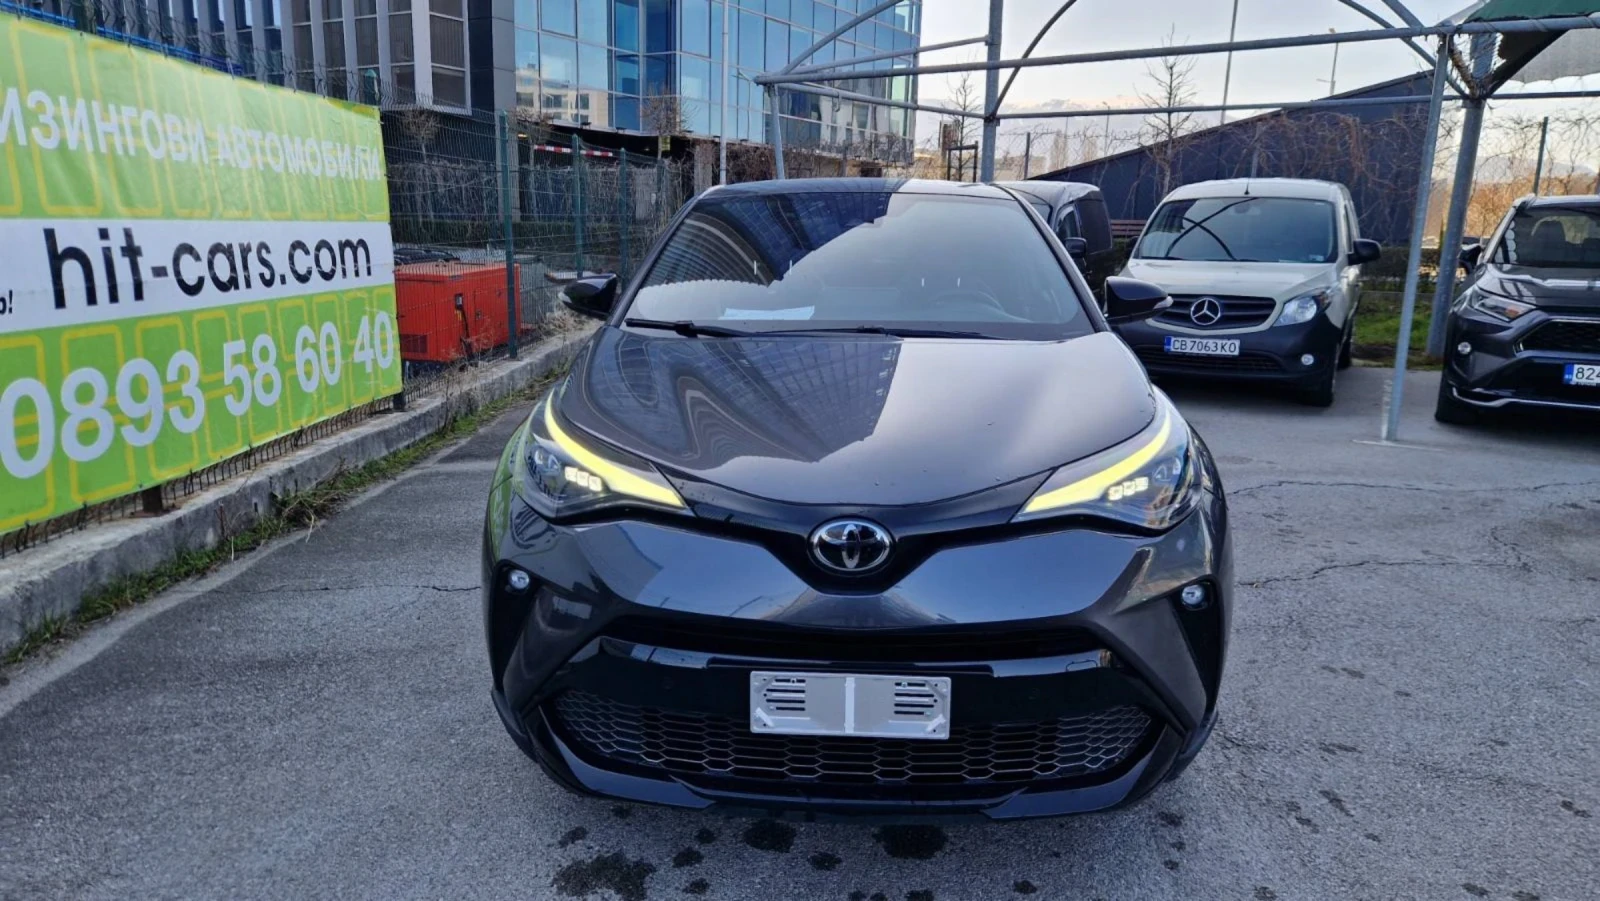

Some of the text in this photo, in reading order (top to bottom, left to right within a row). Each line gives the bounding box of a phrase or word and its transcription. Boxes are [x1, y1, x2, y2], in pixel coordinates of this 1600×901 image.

[216, 123, 381, 181] АВТОМОБИЛИ
[43, 227, 372, 310] hit-cars.com
[0, 310, 394, 479] 0893 58 60 40
